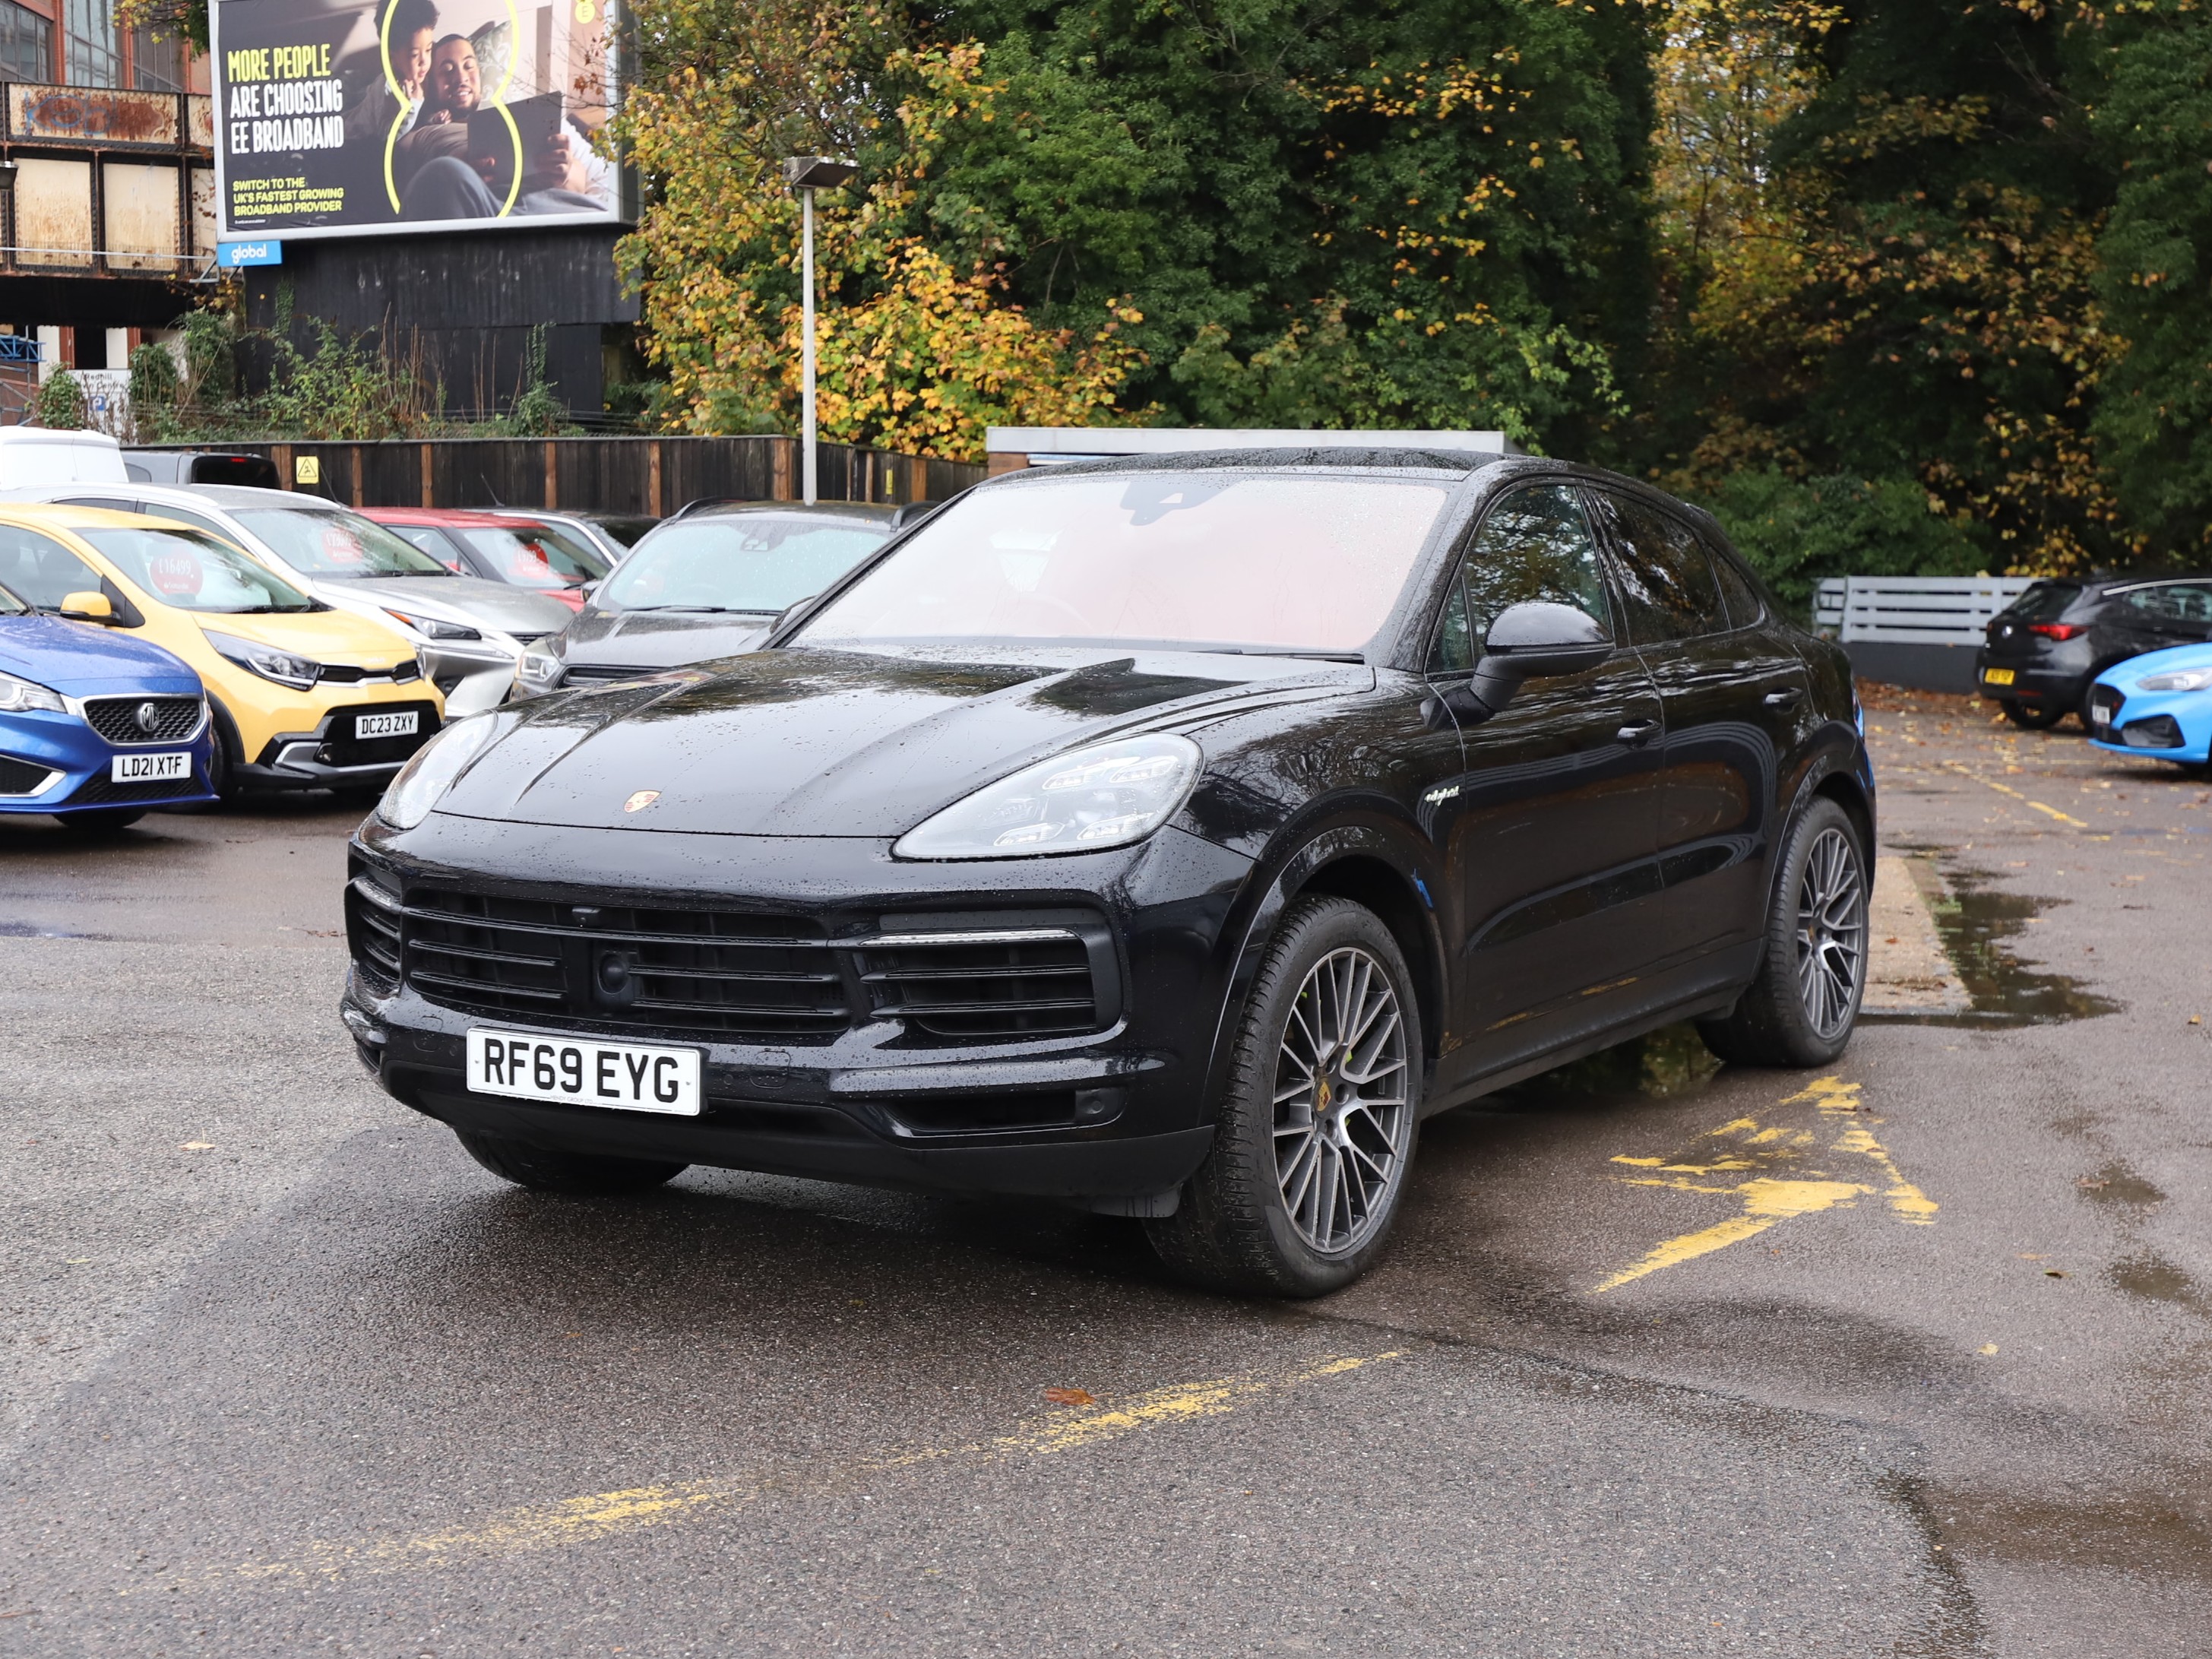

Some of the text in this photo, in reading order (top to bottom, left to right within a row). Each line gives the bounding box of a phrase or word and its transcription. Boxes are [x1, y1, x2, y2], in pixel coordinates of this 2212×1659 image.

[228, 43, 331, 83] MORE PEOPLE
[229, 78, 343, 119] ARE CHOOSING
[231, 115, 344, 154] EE BROADBAND
[233, 177, 305, 192] SWITCH TO THE
[233, 188, 344, 204] UK'S FASTEST GROWING
[234, 200, 342, 217] BROADBAND PROVIDER
[231, 243, 267, 264] global
[361, 714, 414, 735] DC23 ZXY
[122, 755, 183, 777] LD21 XTF
[484, 1037, 679, 1103] RF69 EYG
